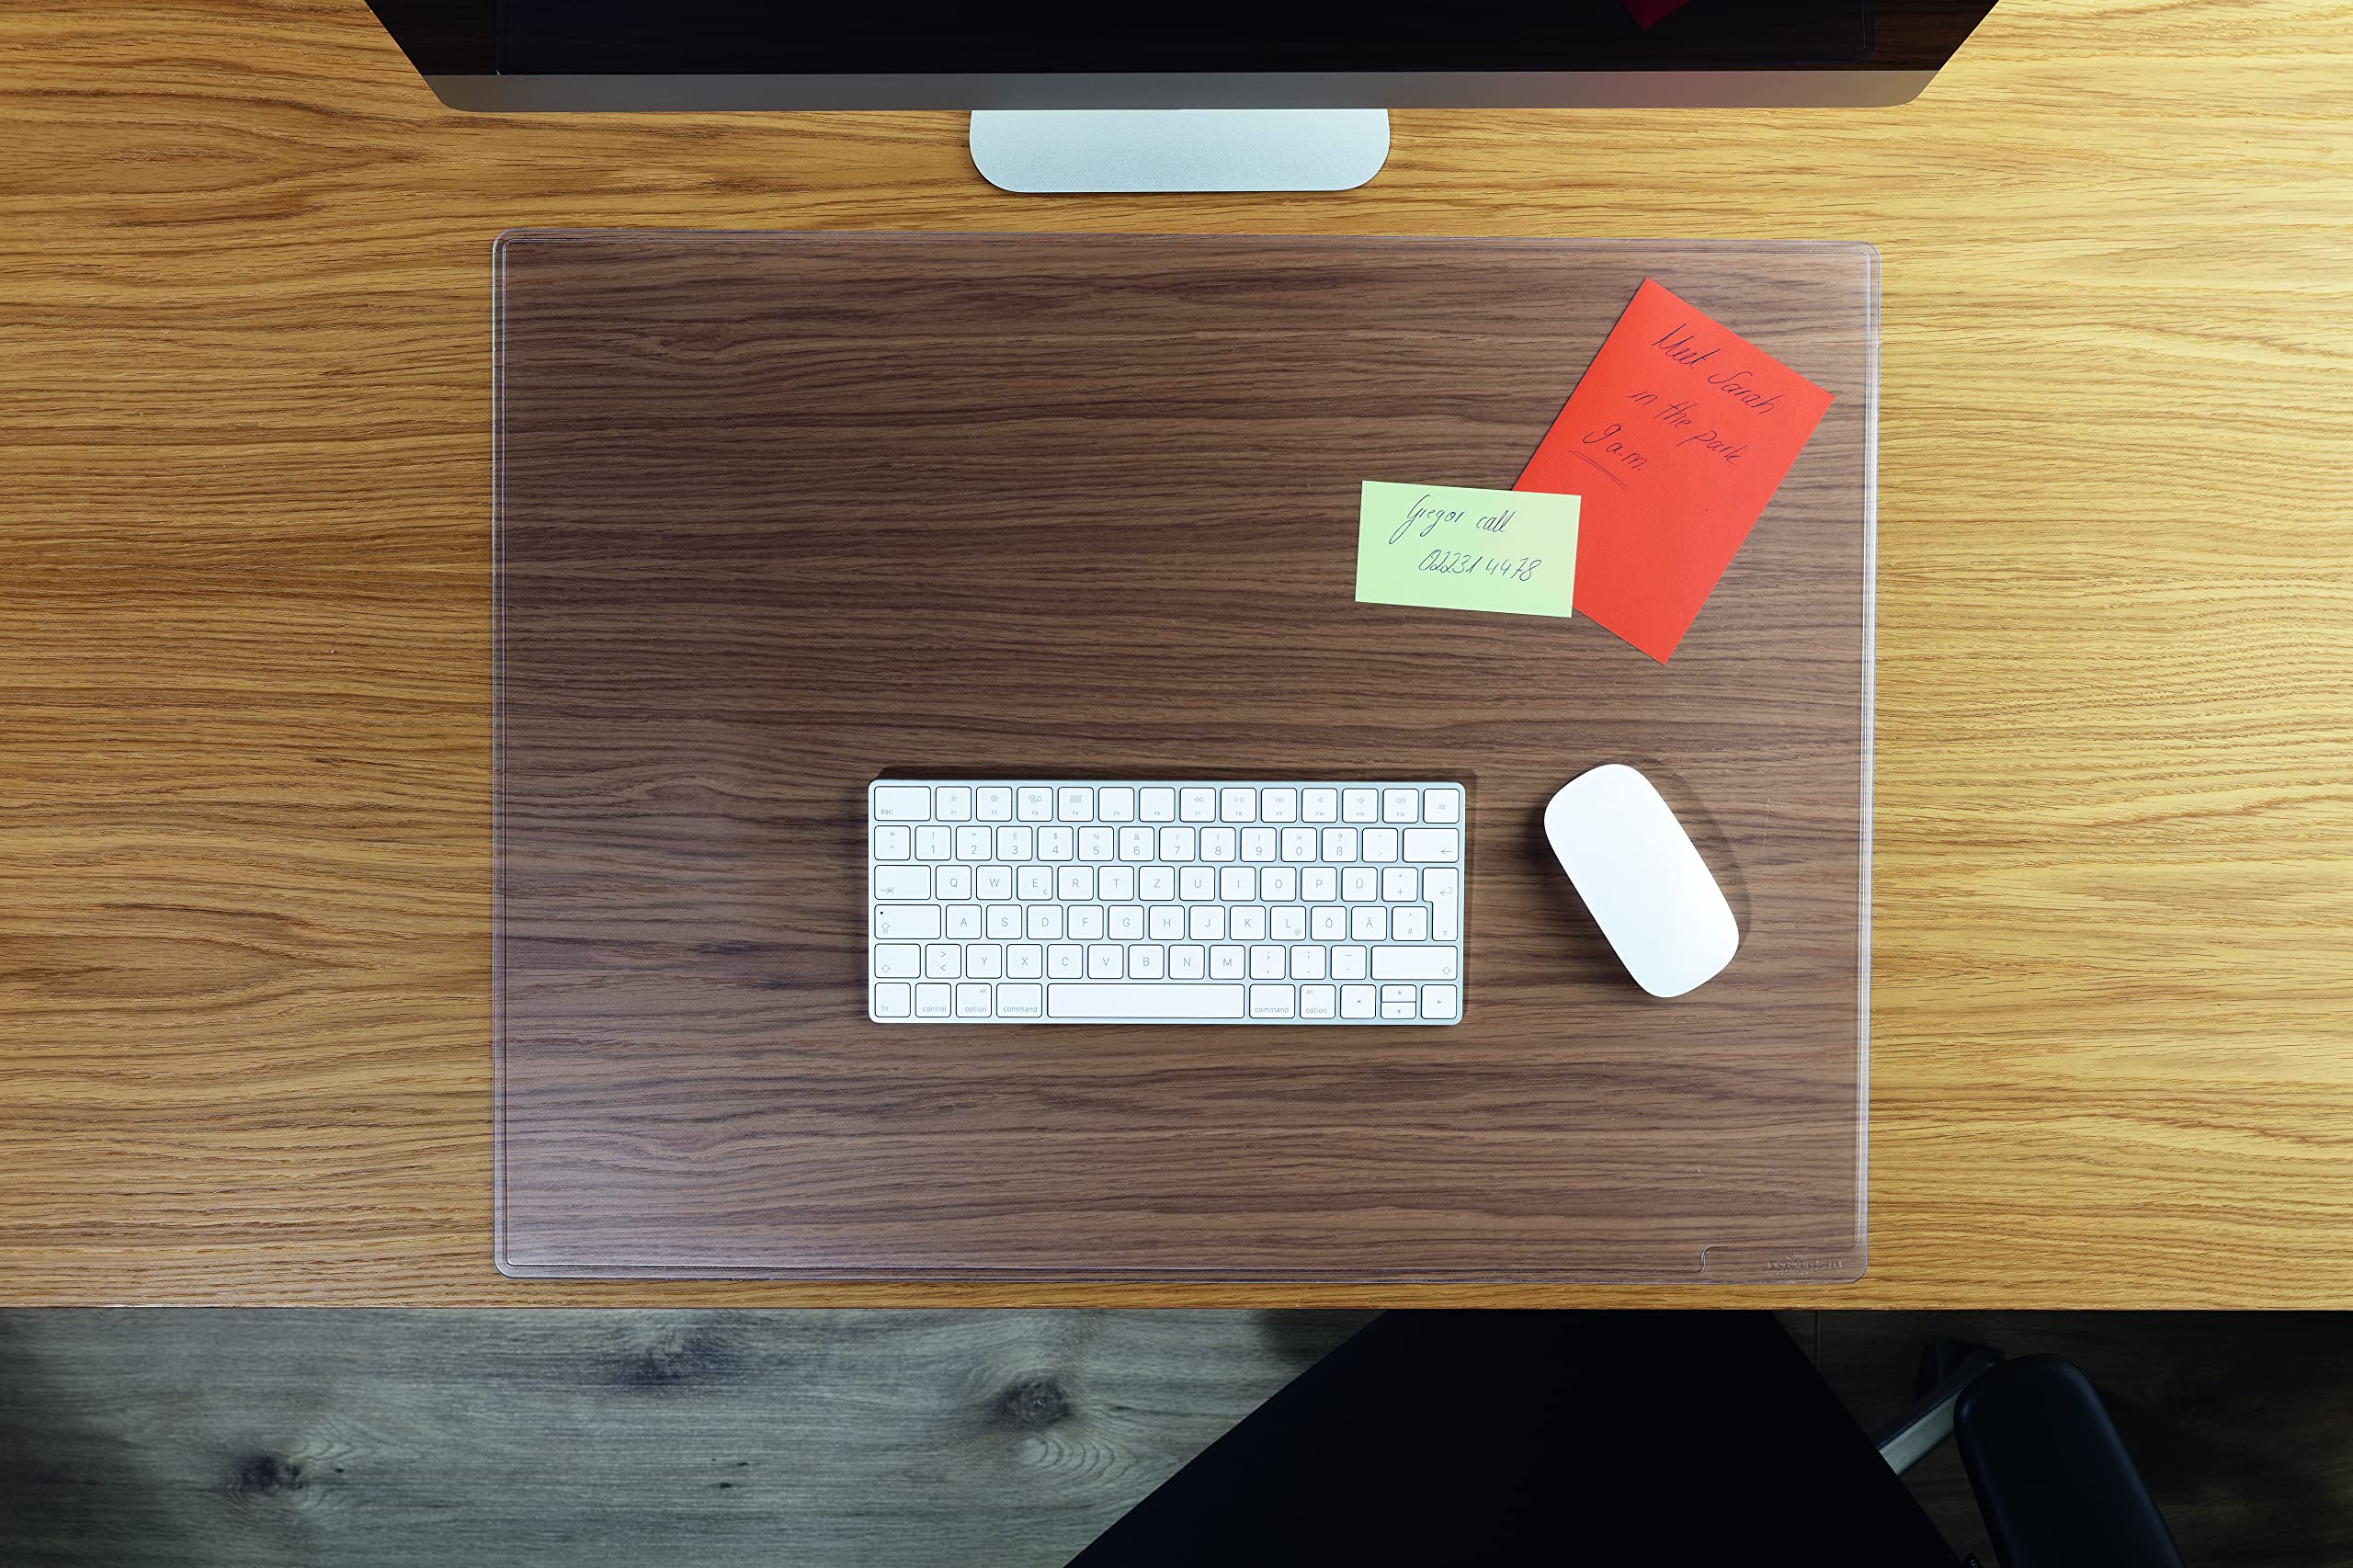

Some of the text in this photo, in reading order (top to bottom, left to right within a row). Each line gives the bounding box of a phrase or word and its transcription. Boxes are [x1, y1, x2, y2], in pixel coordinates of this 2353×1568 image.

[1651, 324, 1786, 415] Meet Sarah
[1626, 391, 1658, 406] in
[1654, 401, 1699, 428] the
[1475, 510, 1516, 533] call
[971, 845, 977, 854] 2
[1011, 846, 1018, 855] 3
[1052, 846, 1059, 854] 4
[1093, 846, 1099, 855] 5
[1133, 846, 1141, 856] 6
[1175, 846, 1181, 855] 7
[1214, 846, 1222, 856] 8
[1256, 846, 1262, 856] 9
[949, 878, 958, 888] Q
[989, 878, 1000, 888] W
[1032, 879, 1039, 888] E
[1073, 879, 1079, 888] R
[1113, 879, 1120, 888] T
[1154, 879, 1160, 888] Z
[1194, 879, 1201, 889] U
[1315, 880, 1323, 889] P
[1356, 878, 1364, 889] Ü
[960, 917, 968, 926] A
[1001, 917, 1008, 926] S
[1041, 918, 1049, 927] D
[1082, 918, 1088, 926] F
[1122, 918, 1131, 927] G
[1164, 918, 1171, 927] H
[1205, 918, 1211, 927] J
[1245, 919, 1252, 927] K
[1286, 919, 1291, 928] L
[1324, 917, 1333, 928] Ö
[1366, 917, 1373, 928] Ä
[981, 956, 988, 965] Y
[1021, 957, 1029, 966] X
[1062, 957, 1069, 966] C
[1103, 958, 1109, 966] V
[1143, 958, 1149, 966] B
[1184, 958, 1190, 966] N
[1223, 958, 1232, 967] M
